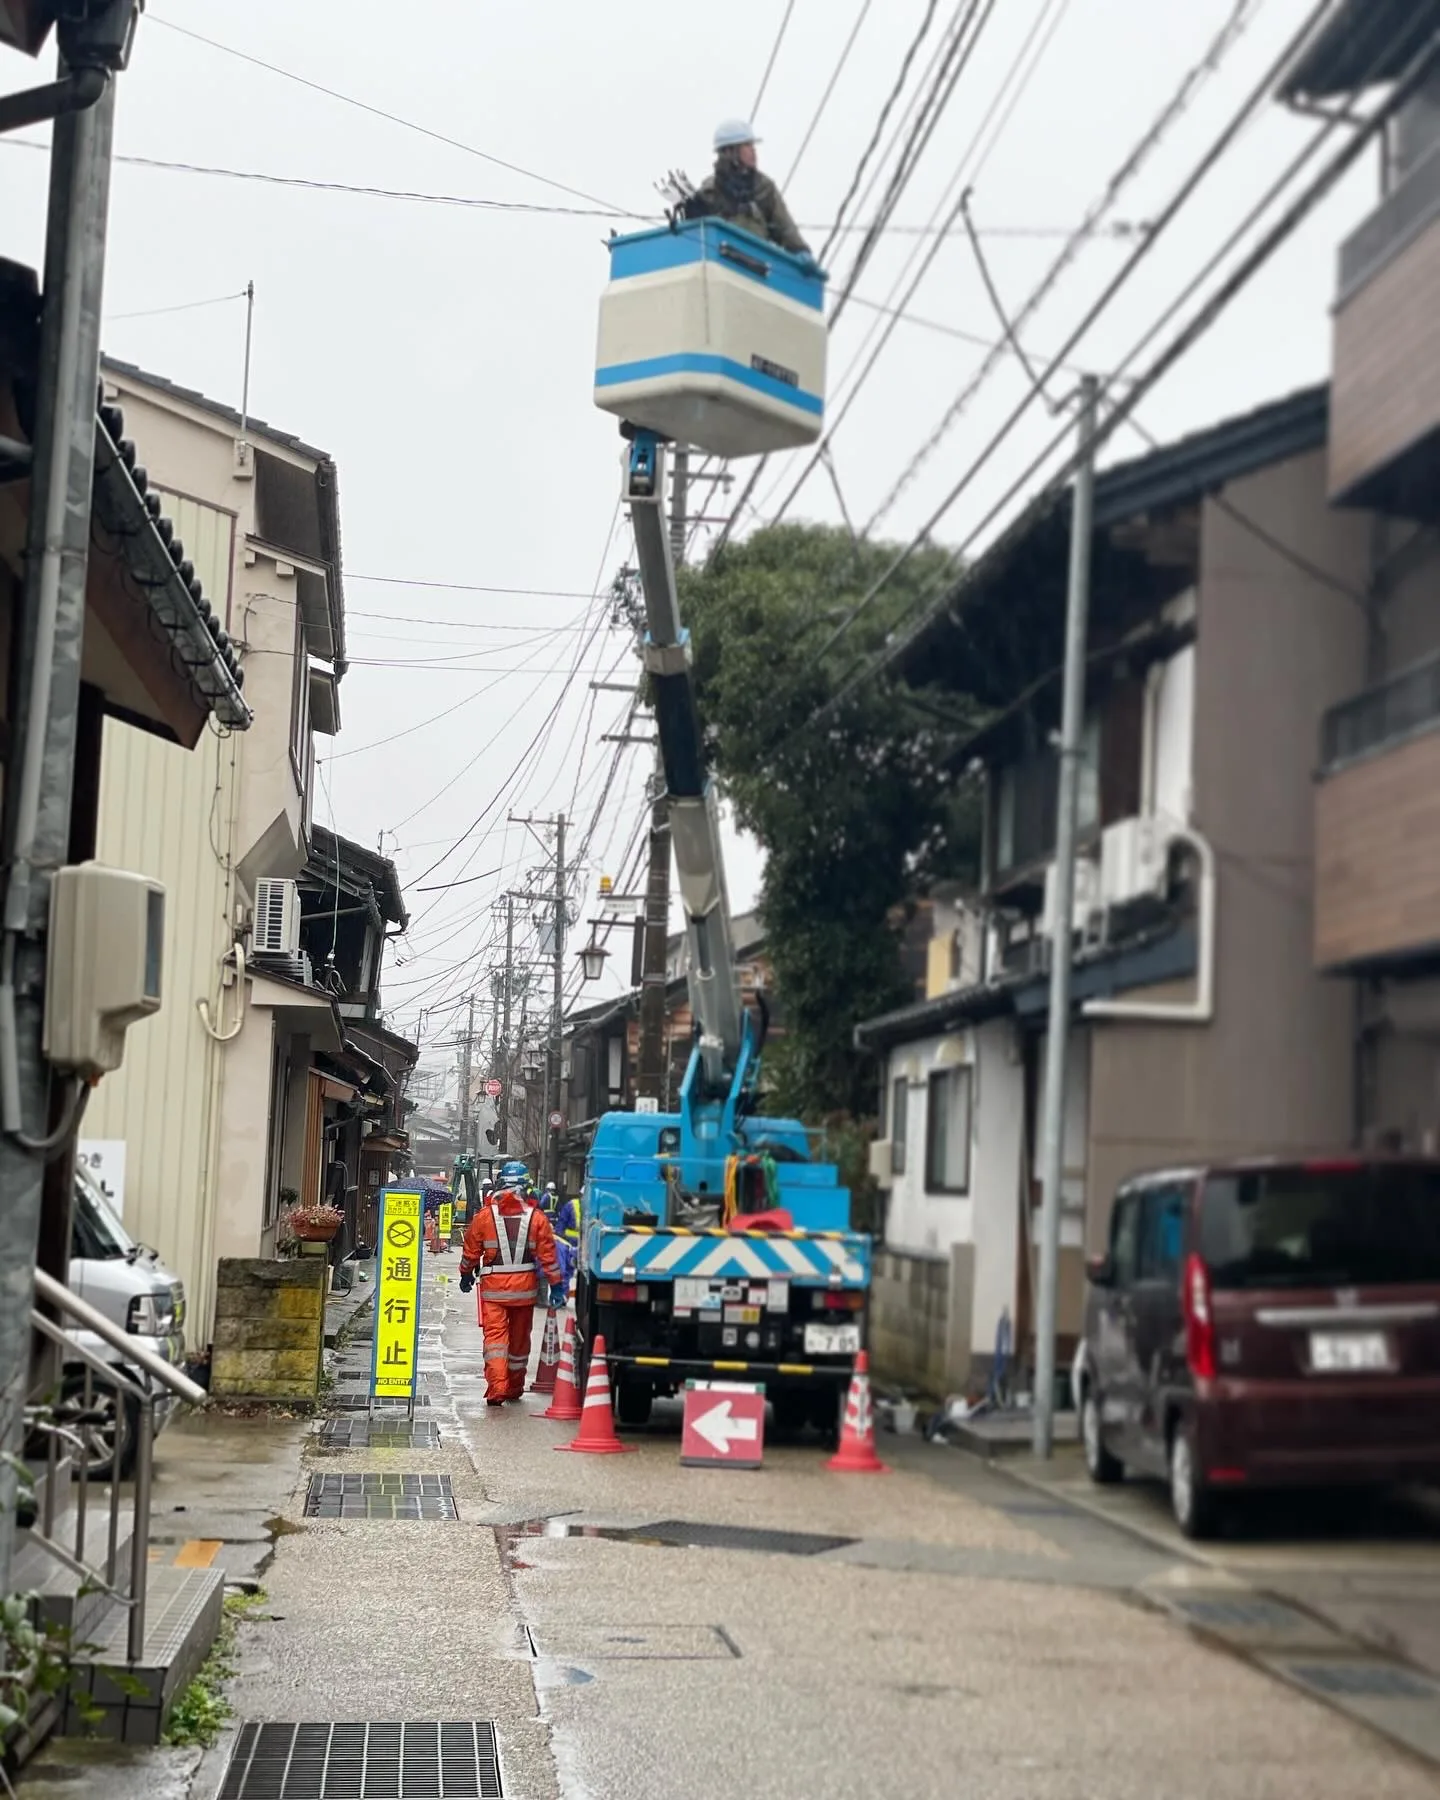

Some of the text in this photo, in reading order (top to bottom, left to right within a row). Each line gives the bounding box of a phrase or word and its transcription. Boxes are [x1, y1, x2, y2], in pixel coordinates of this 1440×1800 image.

[382, 1257, 412, 1365] 通行止
[388, 1378, 410, 1386] ENTRY
